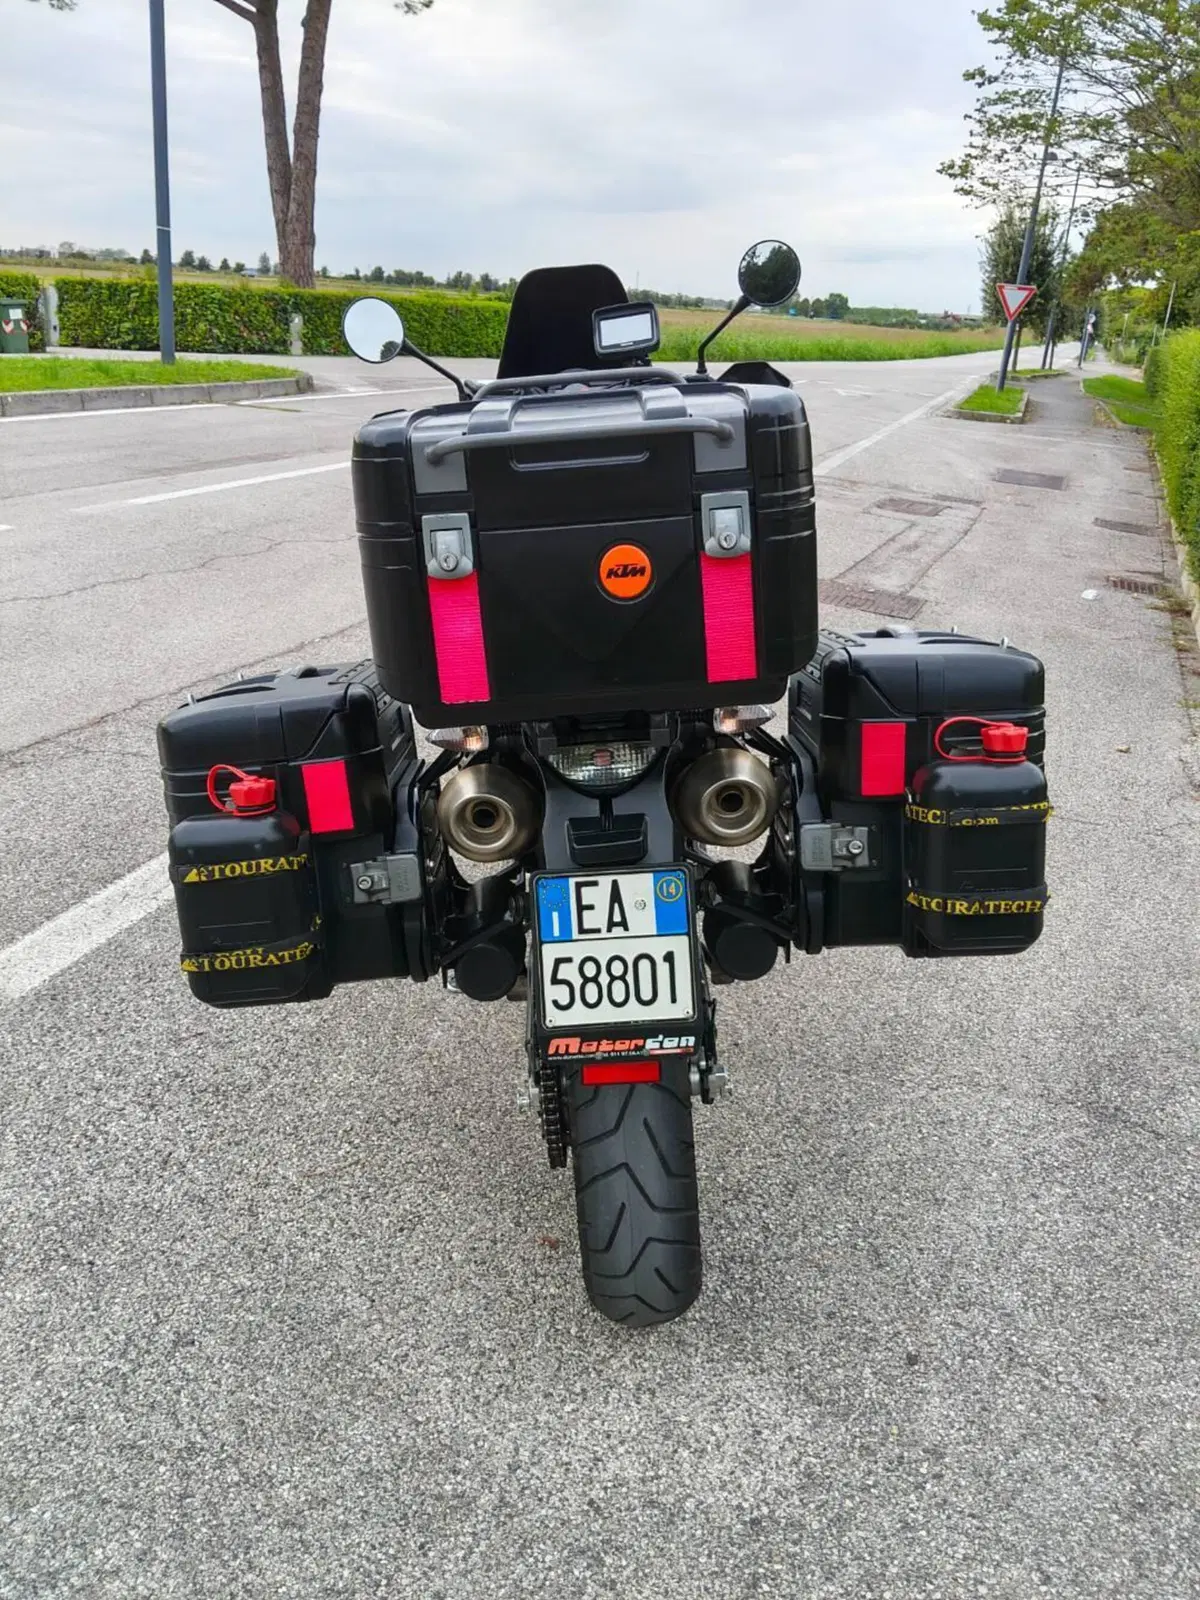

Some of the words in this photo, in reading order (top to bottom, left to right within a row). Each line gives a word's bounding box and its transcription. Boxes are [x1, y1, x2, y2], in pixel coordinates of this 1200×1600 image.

[606, 563, 647, 579] KTM
[574, 878, 630, 935] EA
[663, 881, 677, 897] 14
[550, 950, 678, 1011] 58801
